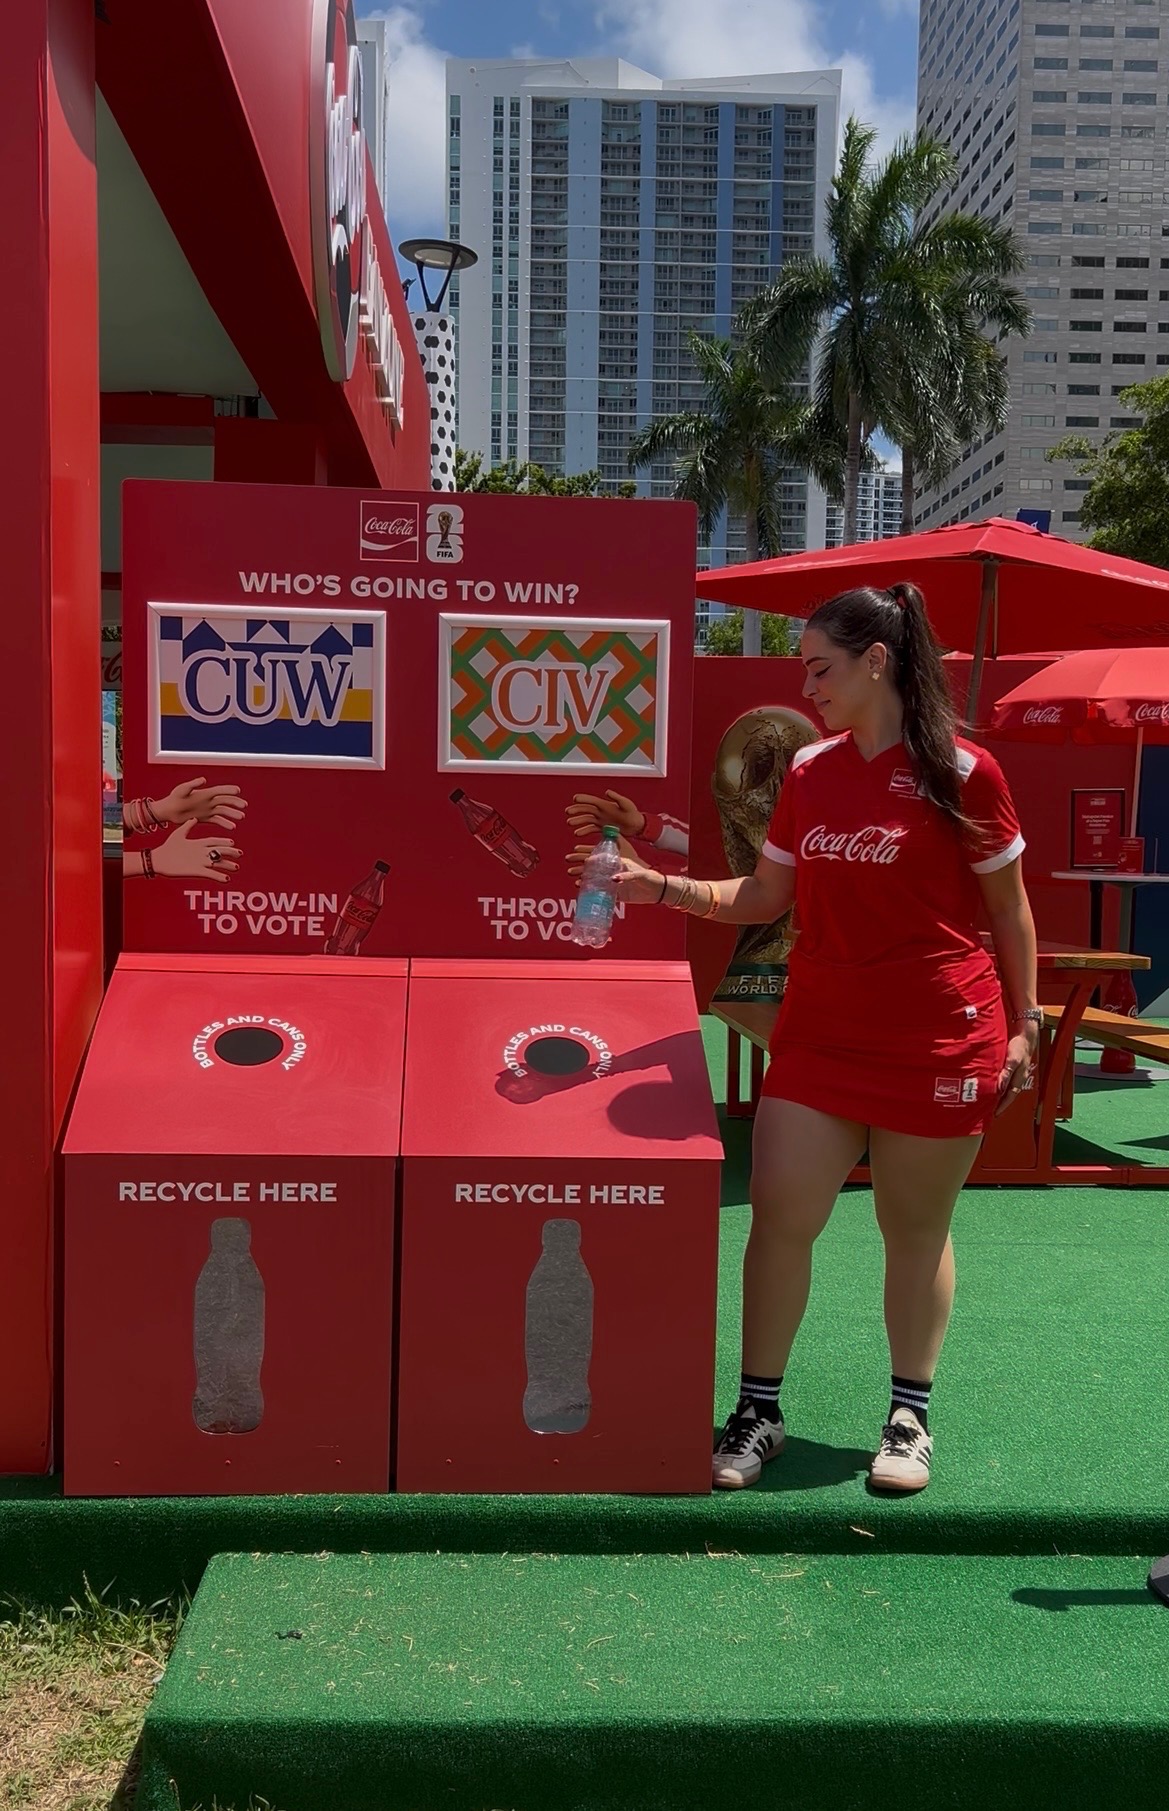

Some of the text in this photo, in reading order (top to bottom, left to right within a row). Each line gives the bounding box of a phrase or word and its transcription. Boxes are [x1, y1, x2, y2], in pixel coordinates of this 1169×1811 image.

[436, 550, 454, 559] FIFA
[239, 571, 579, 605] WHO'S GOING TO WIN?
[184, 655, 352, 721] CUW
[497, 666, 610, 728] CIV
[800, 824, 910, 865] Coca-Cola
[183, 890, 338, 914] THROW-IN
[198, 914, 325, 936] TO VOTE
[491, 920, 529, 940] TO
[193, 1015, 307, 1071] BOTTLES AND CANS ONLY
[504, 1024, 612, 1079] BOTTLES AND CANS ONLY
[119, 1182, 337, 1201] RECYCLE HERE
[455, 1184, 665, 1204] RECYCLE HERE
